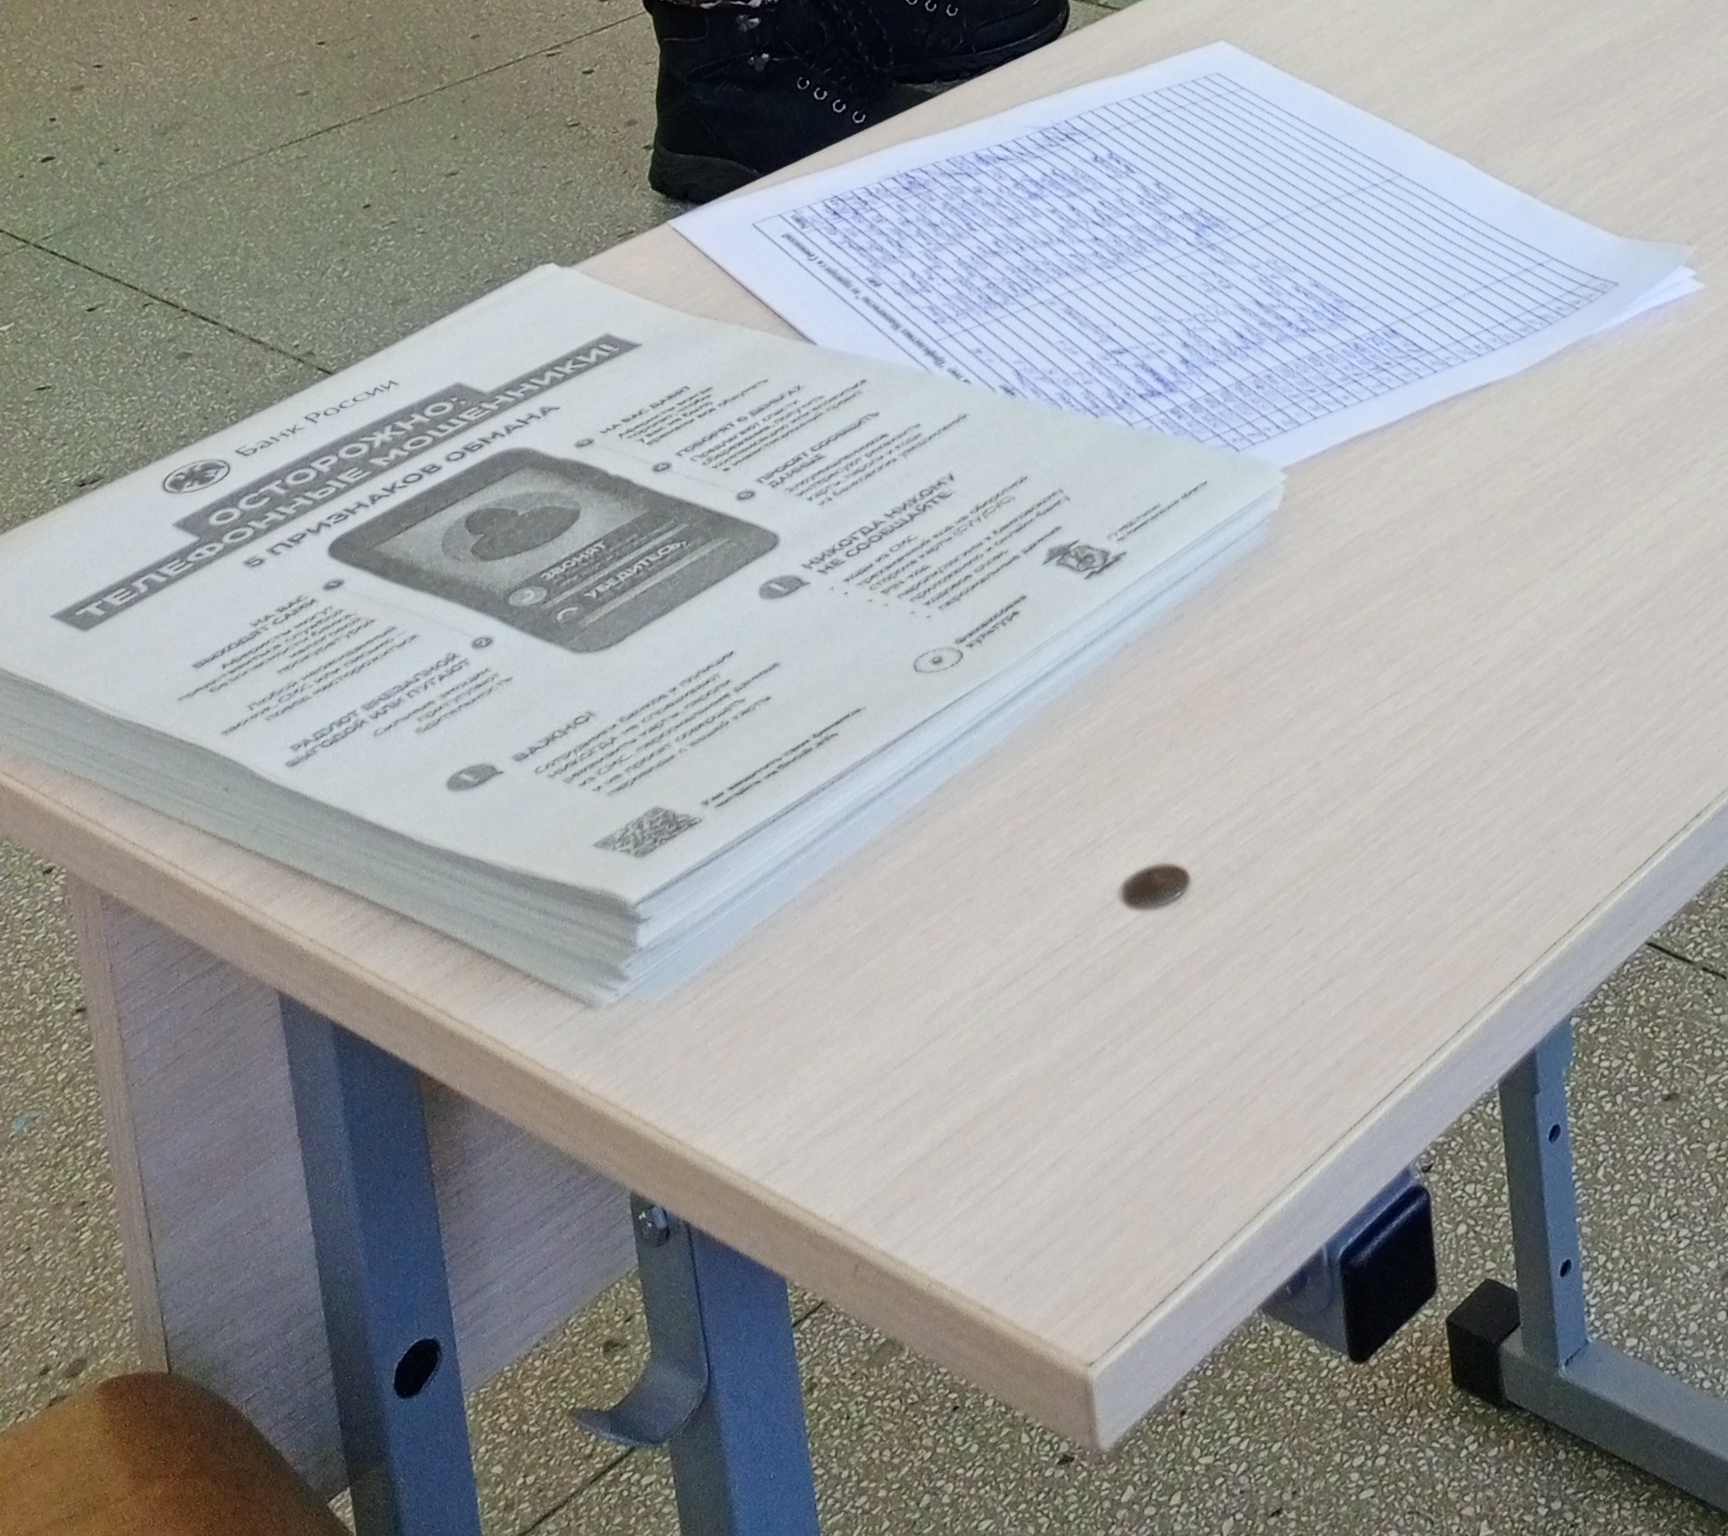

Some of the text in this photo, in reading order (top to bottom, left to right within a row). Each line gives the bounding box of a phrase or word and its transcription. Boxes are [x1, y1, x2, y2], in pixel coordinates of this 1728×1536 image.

[198, 395, 468, 527] ОСТОРОЖНО:
[231, 379, 400, 457] Банк России
[73, 467, 373, 620] ТЕЛЕФОННЫЕ
[367, 343, 621, 466] МОШЕННИКИ!
[239, 556, 266, 568] 5
[265, 463, 444, 554] ПРИЗНАКОВ
[441, 403, 561, 462] ОБМАНА
[797, 518, 888, 569] НИКОГДА
[879, 472, 962, 519] НИКОМУ
[537, 540, 613, 580] ЗВОНЯТ
[814, 557, 846, 574] НЕ
[508, 710, 599, 762] ВАЖНО!
